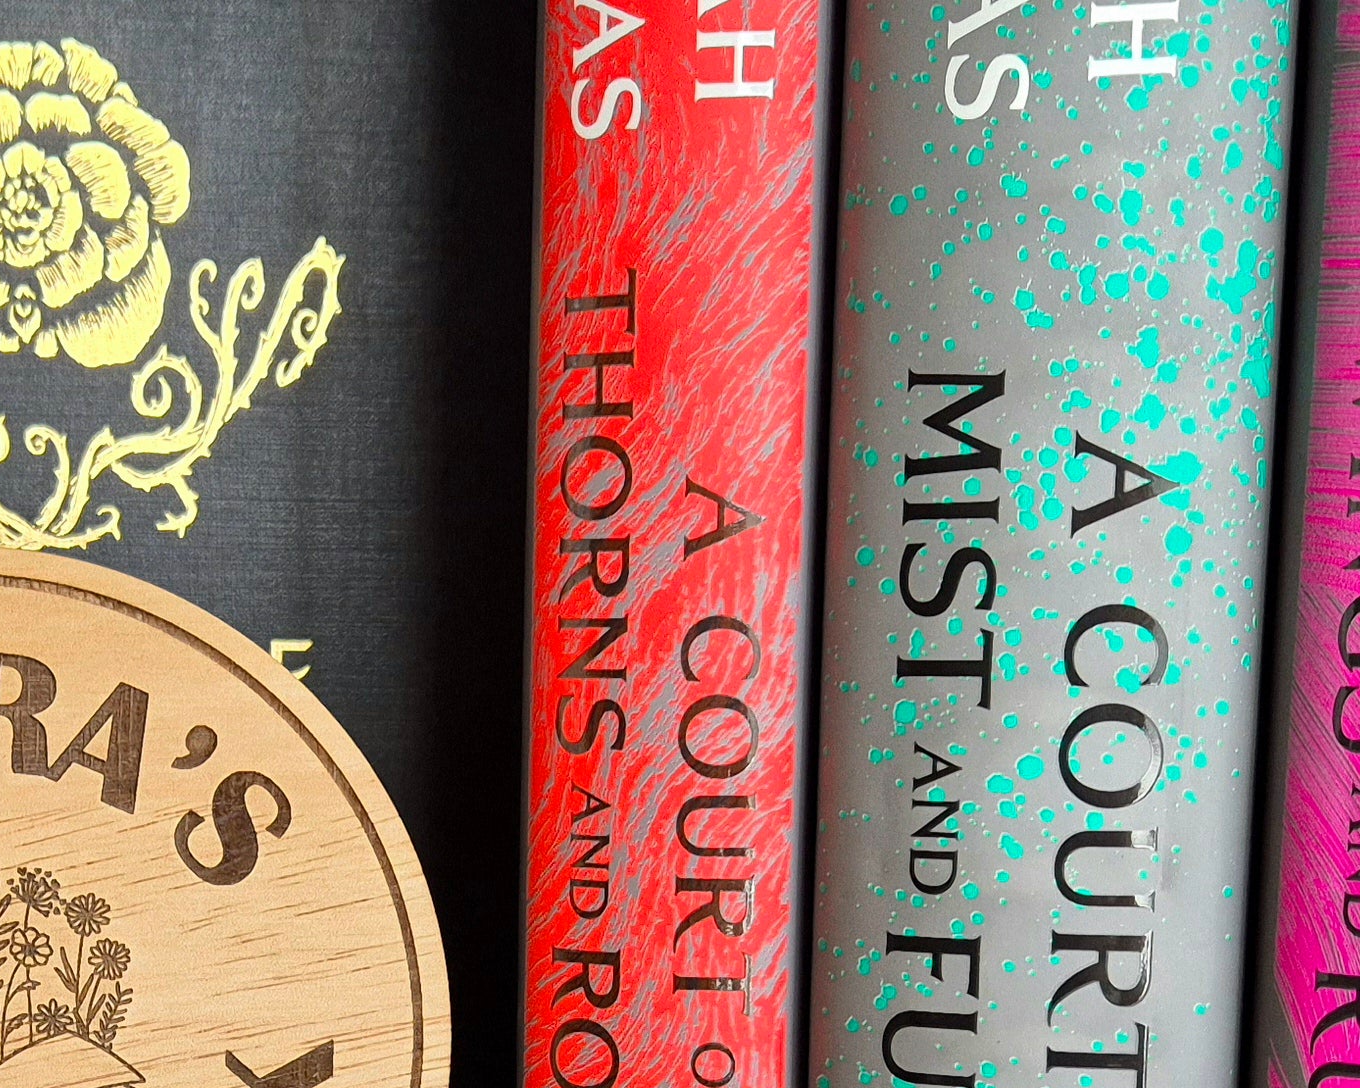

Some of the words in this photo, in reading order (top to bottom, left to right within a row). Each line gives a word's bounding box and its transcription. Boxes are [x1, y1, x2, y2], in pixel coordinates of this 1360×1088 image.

[695, 0, 776, 103] H
[553, 267, 637, 756] THORNS
[683, 477, 767, 562] A
[896, 368, 1007, 709] MIST
[1070, 430, 1182, 539] A
[568, 786, 611, 920] AND
[671, 617, 762, 1017] COURT
[908, 741, 963, 896] AND
